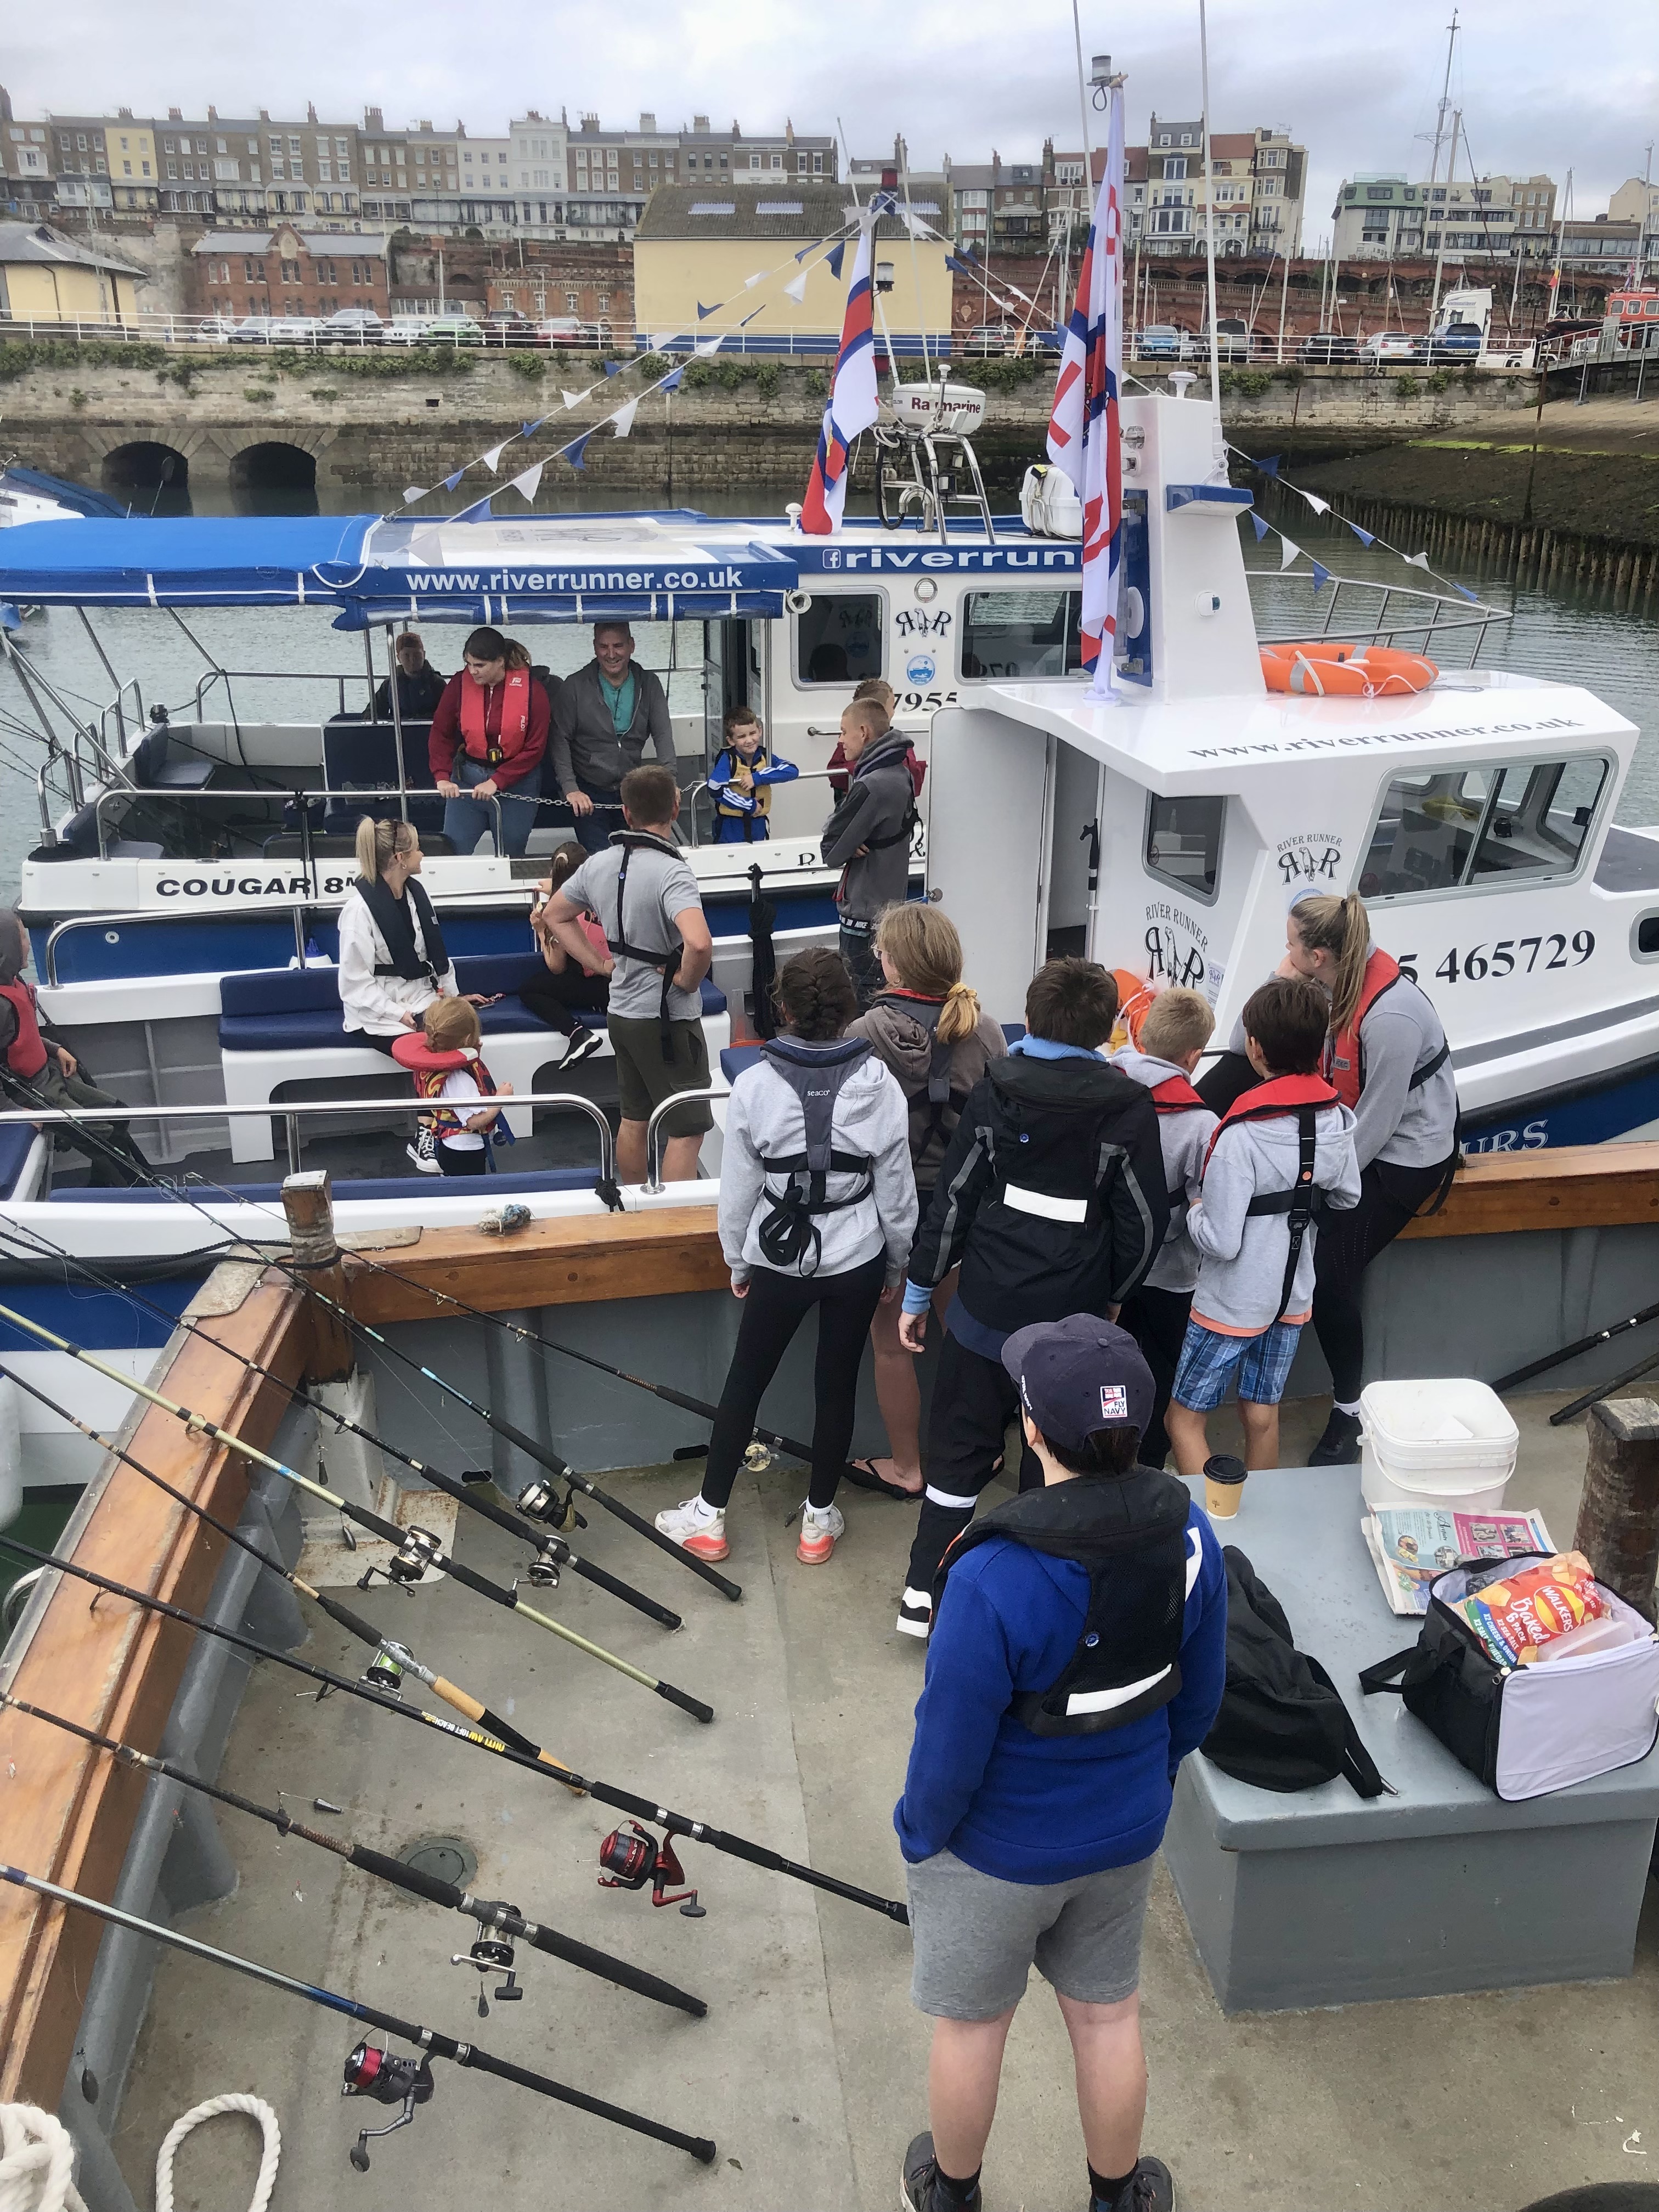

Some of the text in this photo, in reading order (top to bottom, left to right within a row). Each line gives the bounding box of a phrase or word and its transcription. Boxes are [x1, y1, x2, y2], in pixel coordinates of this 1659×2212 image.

[846, 549, 1083, 568] riverrun
[405, 566, 743, 591] www.riverrunner.co.uk
[1187, 718, 1586, 759] www.riverrunner.co.uk
[1277, 833, 1342, 853] RIVER RUNNER
[156, 878, 311, 896] COUGAR
[1146, 901, 1208, 953] RIVER RUNNER
[1435, 930, 1595, 984] 465729
[1510, 1597, 1551, 1644] Baked
[1542, 1587, 1574, 1633] WALKERS
[1477, 1626, 1489, 1639] SALT
[1486, 1620, 1503, 1641] CHEESE
[1502, 1645, 1517, 1663] ONION
[1500, 1625, 1511, 1638] SEA
[1509, 1636, 1520, 1650] SALT
[1506, 1612, 1527, 1644] 6 PACK
[435, 1717, 456, 1732] BEACH
